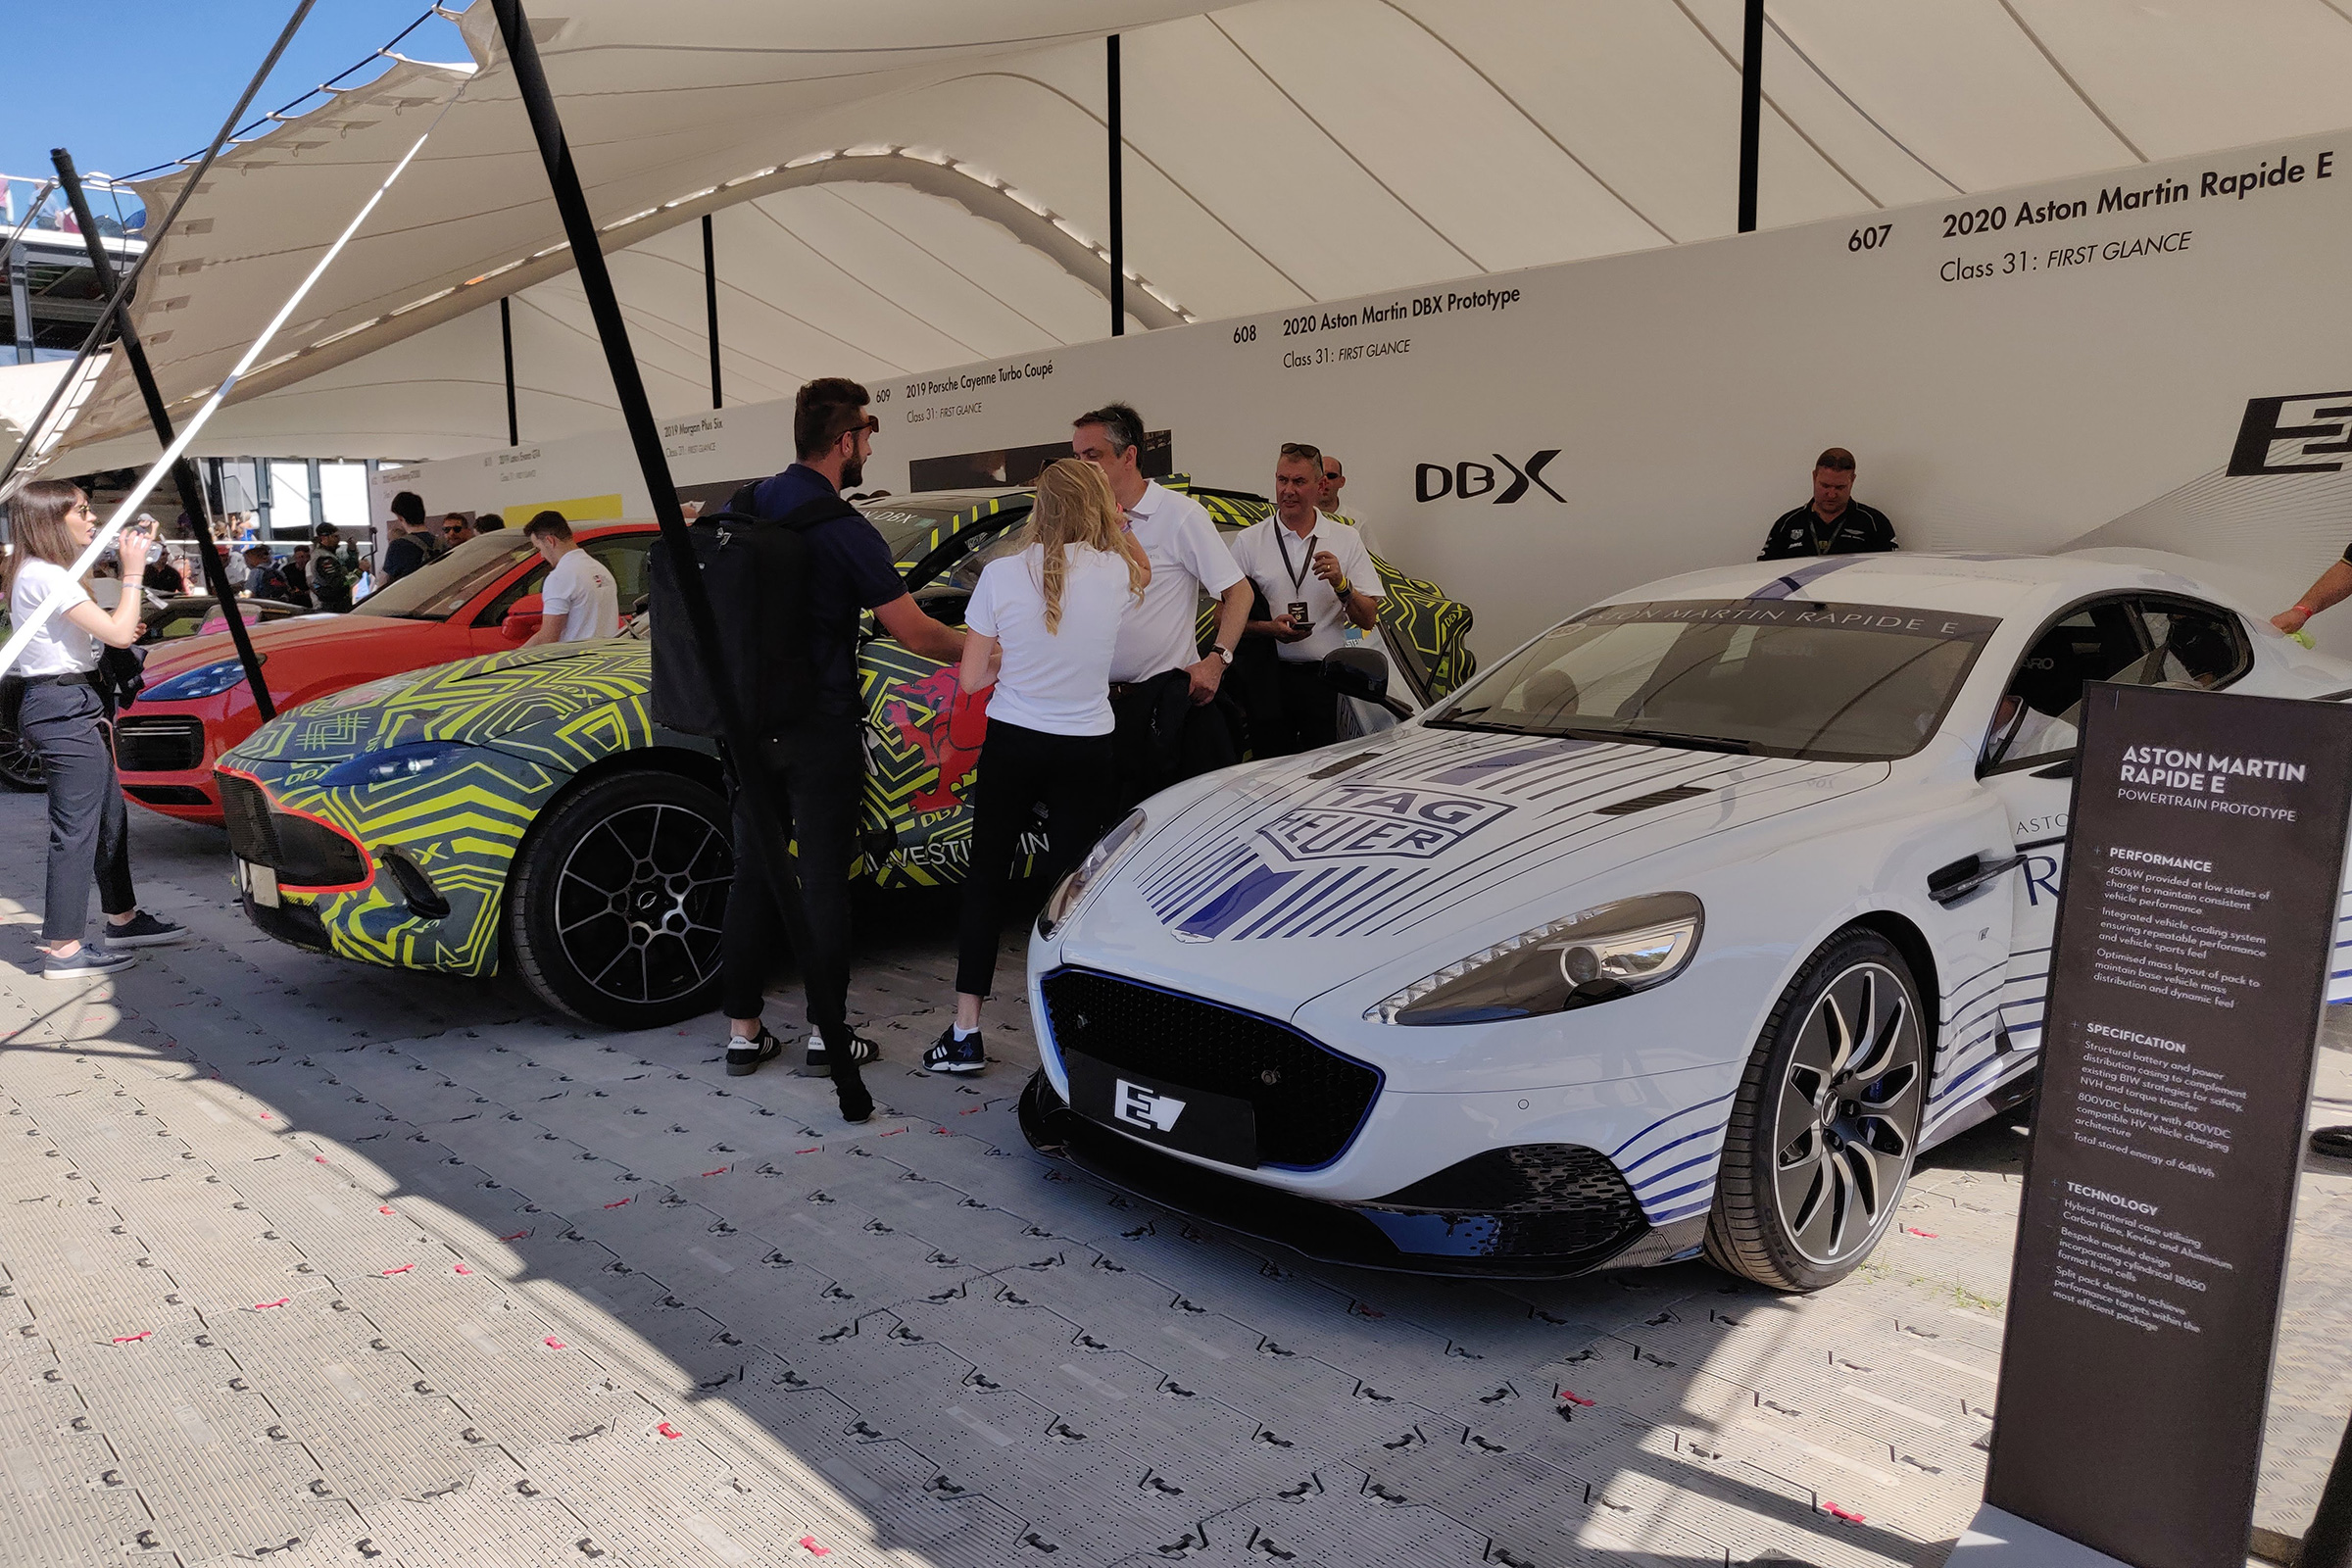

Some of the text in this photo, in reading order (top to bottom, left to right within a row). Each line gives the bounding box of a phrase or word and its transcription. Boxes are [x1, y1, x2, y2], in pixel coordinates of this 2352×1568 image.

[1942, 152, 2333, 238] 2020 Aston Martin Rapide E
[1847, 224, 1892, 252] 607
[1940, 231, 2192, 282] Class 31: FIRST GLANCE
[1283, 286, 1521, 337] 2020 Aston Martin DBX Prototype
[1232, 324, 1257, 345] 608
[1283, 339, 1410, 369] Class 31: FIRST GLANCE
[876, 389, 890, 403] 609
[906, 360, 1054, 399] 2019 Porsche Cayenne Turbo Coupé
[664, 418, 723, 437] 2019 Morgan Plus Six
[906, 403, 982, 423] Class 31: FIRST GLANCE
[1415, 449, 1568, 505] DBX
[874, 512, 917, 523] DBX
[1446, 604, 1468, 628] DBX
[1668, 608, 1958, 634] MARTIN RAPIDE E
[2120, 765, 2226, 794] RAPIDE E
[2123, 746, 2306, 783] ASTON MARTIN
[1327, 787, 1486, 825] TAG
[2118, 789, 2296, 822] POWERTRAIN PROTOTYPE
[1020, 832, 1050, 855] IN
[1272, 812, 1446, 854] HEUER
[2110, 848, 2212, 872] PERFORMANCE
[2106, 880, 2138, 892] charge
[2154, 889, 2196, 901] maintain
[2199, 896, 2250, 909] consistent
[2107, 867, 2143, 879] 450kW
[2145, 874, 2189, 887] provided
[2205, 881, 2222, 892] low
[2225, 887, 2256, 898] states
[2259, 891, 2271, 900] of
[2104, 892, 2202, 914] vehicle performance
[2100, 921, 2266, 957] ensuring repeatable performance
[2102, 907, 2266, 944] Integrated vehicle cooling system
[2120, 937, 2152, 948] vehicle
[2155, 944, 2184, 955] sports
[2187, 948, 2206, 958] feel
[2095, 962, 2227, 994] maintain base vehicle mass
[2097, 949, 2145, 964] Optimised
[2148, 960, 2172, 970] mass
[2175, 963, 2205, 977] layout
[2221, 975, 2245, 984] pack
[2249, 979, 2260, 988] to
[2093, 972, 2234, 1008] distribution and dynamic feel
[2087, 1023, 2185, 1054] SPECIFICATION
[2083, 1054, 2135, 1072] distribution
[2138, 1067, 2170, 1082] casing
[2184, 1079, 2246, 1099] complement
[2085, 1041, 2131, 1058] Structural
[2133, 1052, 2169, 1068] battery
[2192, 1068, 2224, 1080] power
[2081, 1076, 2198, 1112] NVH and torque transfer
[2082, 1066, 2207, 1102] existing BIW strategies for
[2075, 1118, 2132, 1137] architecture
[2077, 1106, 2229, 1152] compatible HV vehicle charging
[2078, 1092, 2230, 1139] 800VDC battery with 400VDC
[2074, 1132, 2095, 1145] Total
[2098, 1140, 2128, 1153] stored
[2130, 1150, 2163, 1164] energy
[2179, 1162, 2214, 1178] 64kWh
[2067, 1182, 2158, 1216] TECHNOLOGY
[2063, 1211, 2097, 1228] Carbon
[2127, 1231, 2157, 1246] Kevlar
[2159, 1243, 2179, 1252] and
[2065, 1200, 2095, 1215] Hybrid
[2097, 1210, 2136, 1227] material
[2138, 1223, 2161, 1235] case
[2060, 1240, 2122, 1266] incorporating
[2124, 1260, 2172, 1280] cylindrical
[2061, 1227, 2171, 1268] Bespoke module design
[2058, 1250, 2088, 1266] format
[2115, 1270, 2136, 1282] cells
[2055, 1279, 2200, 1333] performance targets within the
[2056, 1266, 2185, 1315] Split pack design to achieve
[2053, 1291, 2158, 1331] most efficient package
